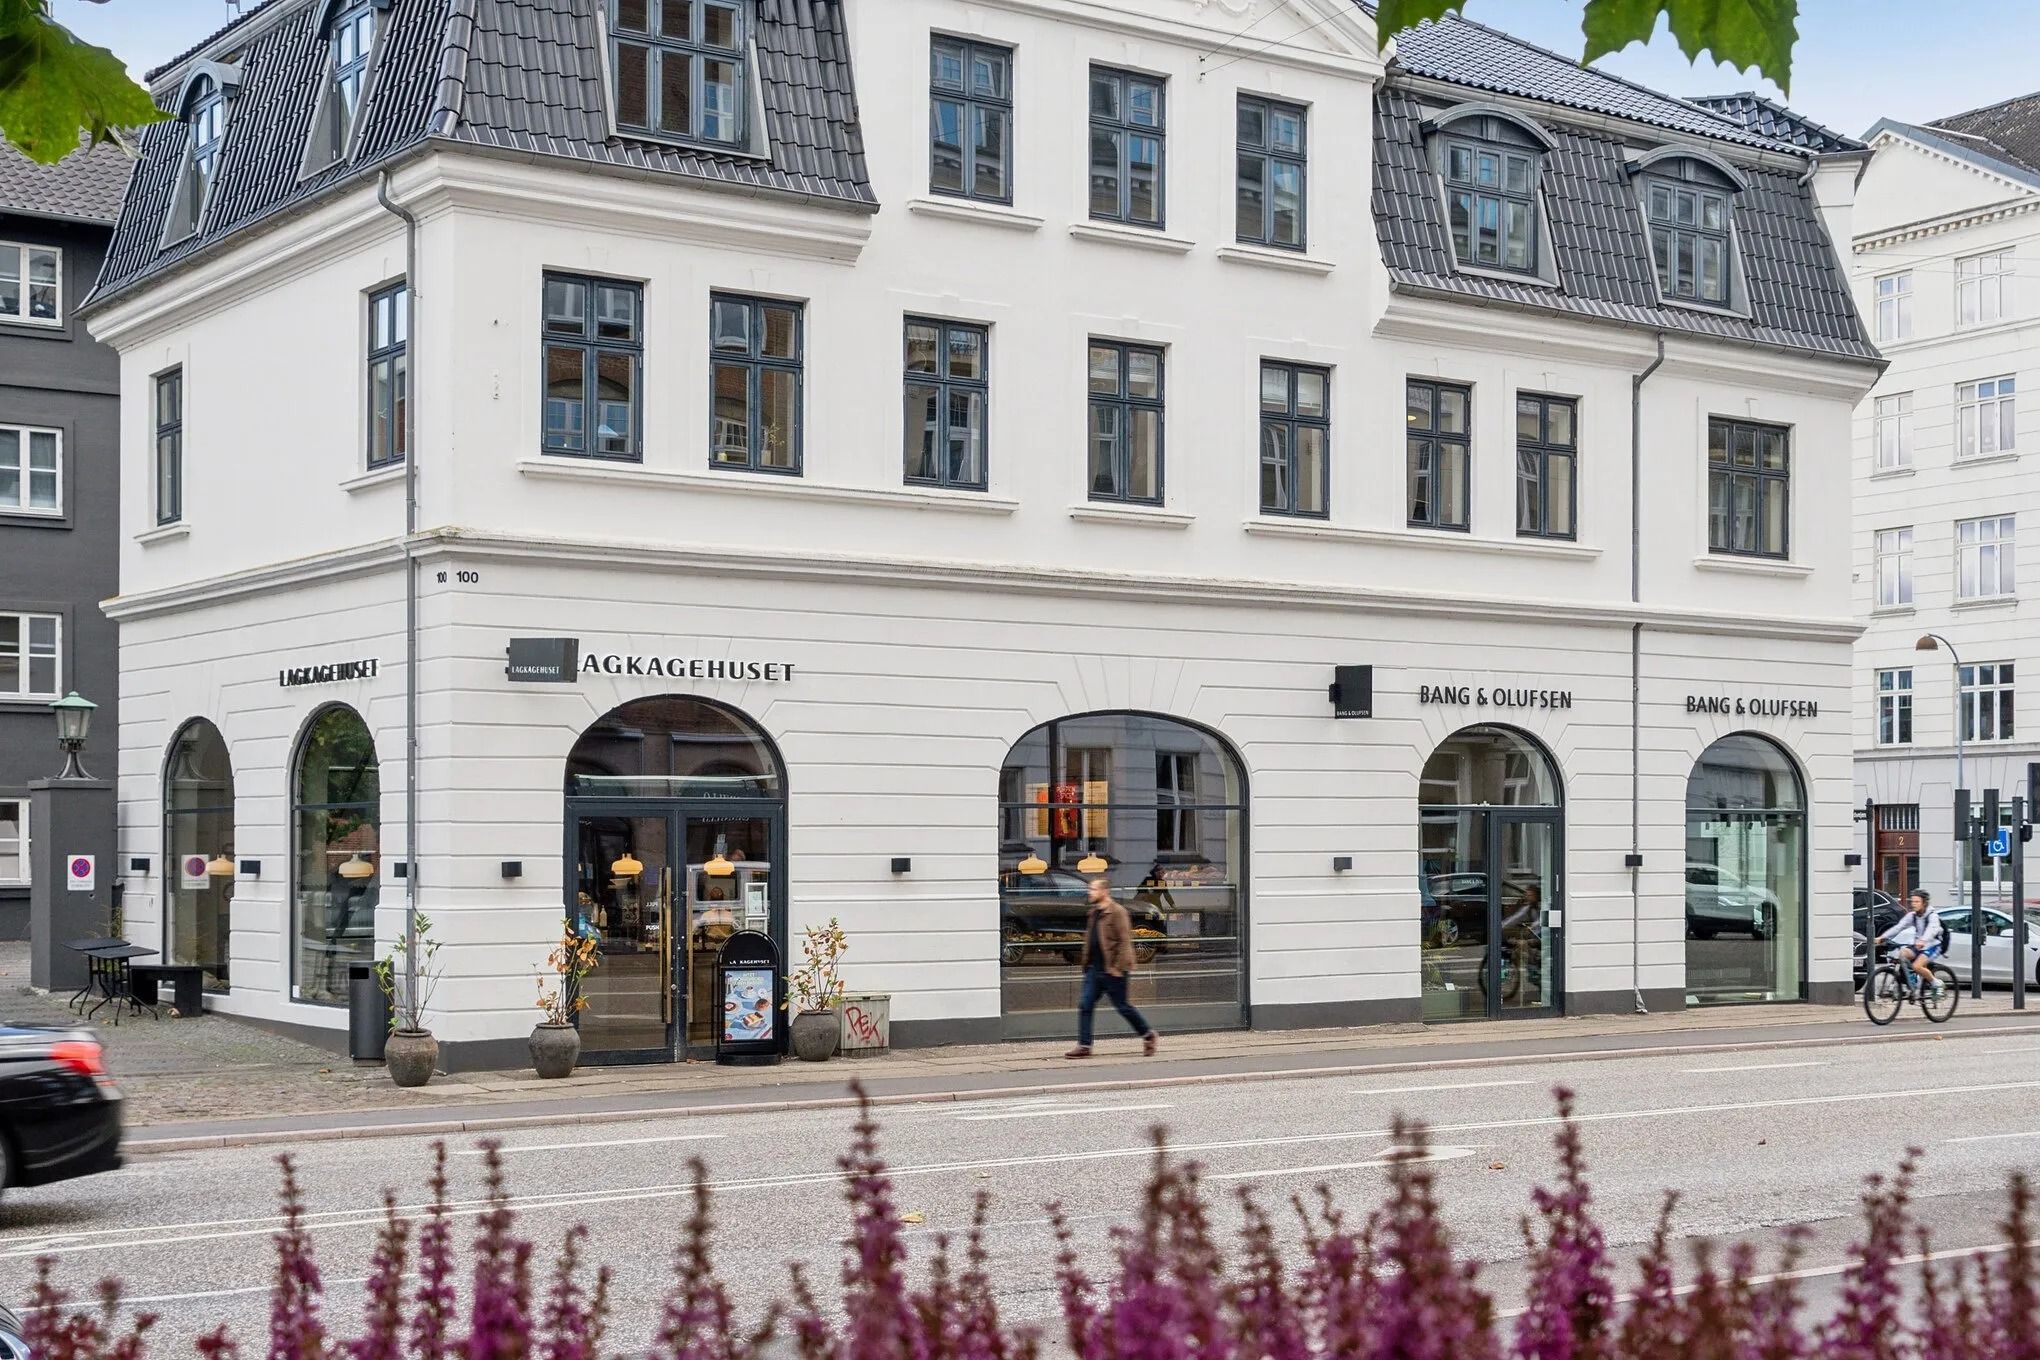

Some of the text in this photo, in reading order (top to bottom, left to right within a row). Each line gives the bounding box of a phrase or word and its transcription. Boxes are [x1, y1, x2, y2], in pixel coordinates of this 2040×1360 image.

[456, 570, 479, 583] 100
[279, 658, 379, 687] LAGKAGEHUSET
[511, 665, 561, 675] LAGKAGEHUSET
[577, 653, 796, 682] AGKAGEHUSET
[1420, 685, 1572, 709] BANG & OLUFSEN
[1686, 695, 1818, 717] BANG & OLUFSEN
[1898, 836, 1904, 846] 2
